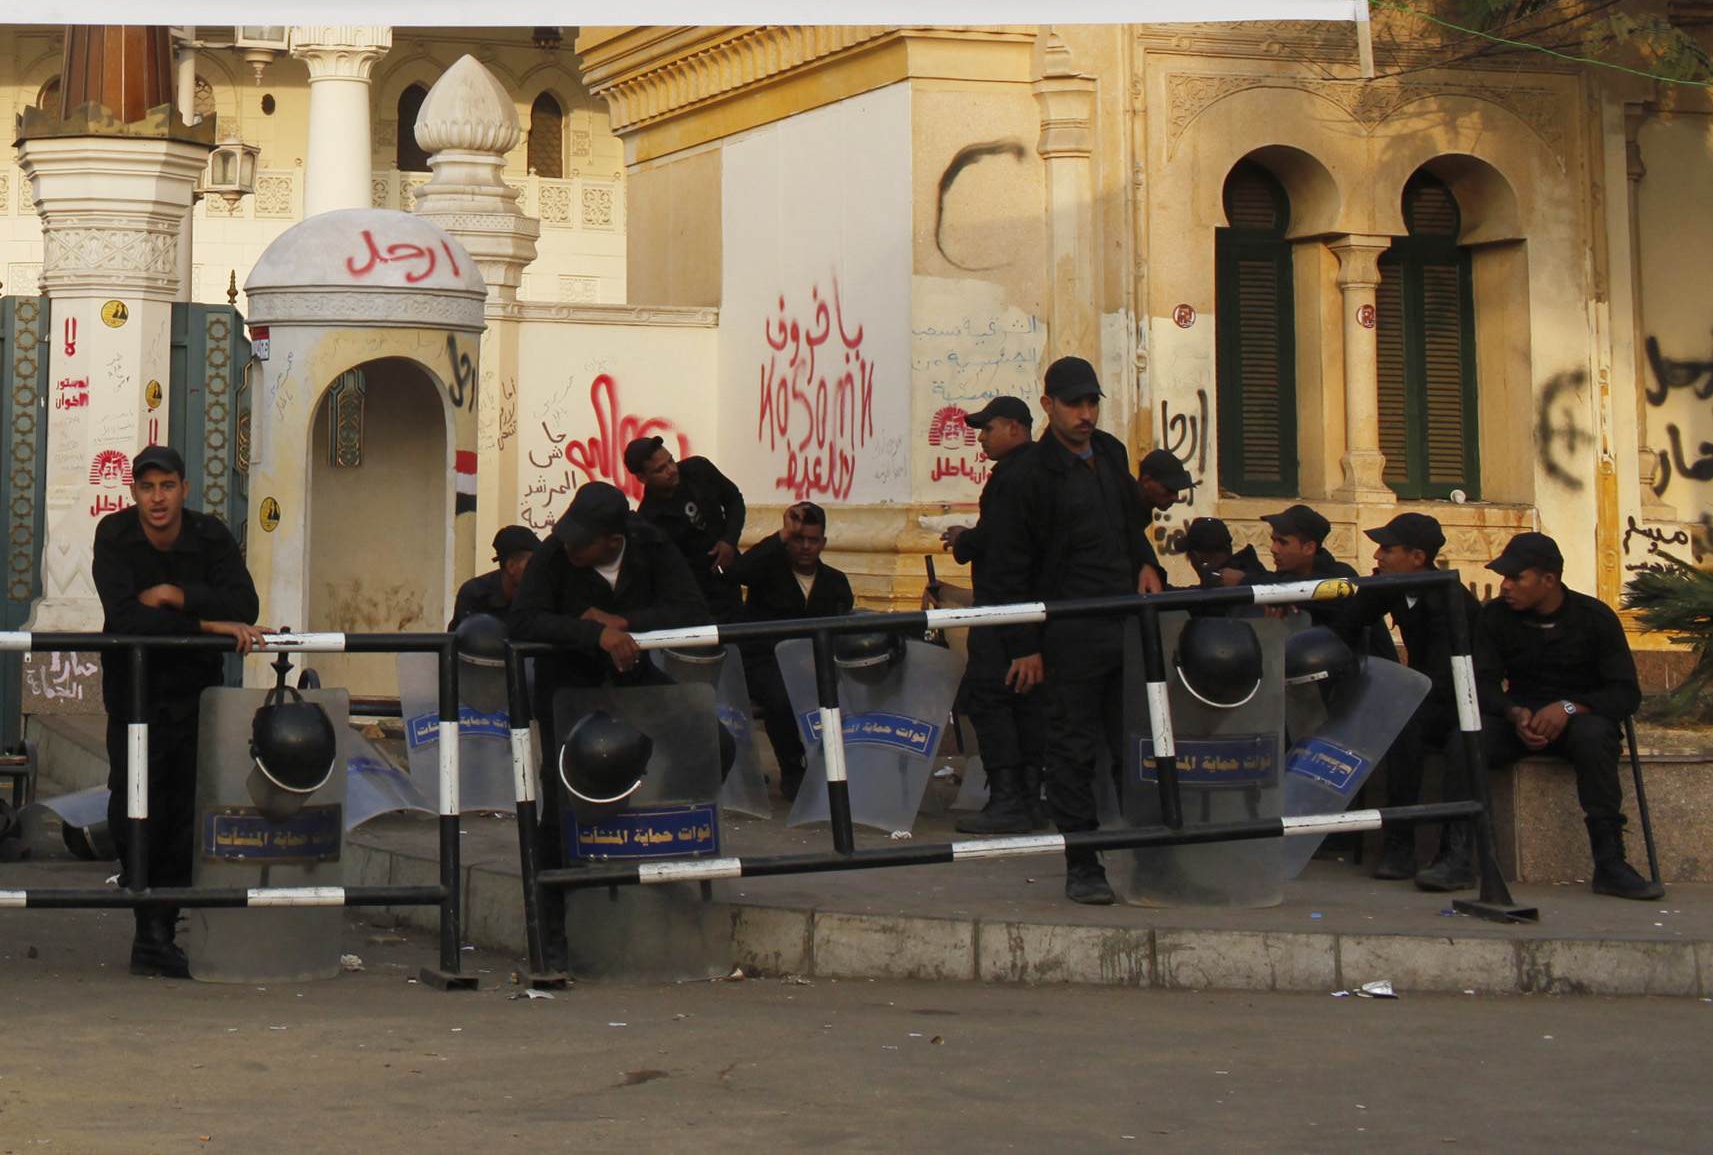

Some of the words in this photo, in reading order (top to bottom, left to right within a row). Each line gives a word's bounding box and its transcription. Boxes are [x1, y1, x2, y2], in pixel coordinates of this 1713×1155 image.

[346, 230, 460, 283] ارحل
[931, 456, 974, 482] باطل
[579, 825, 629, 845] المنشآت
[634, 828, 674, 847] حماية
[679, 823, 712, 843] قوات
